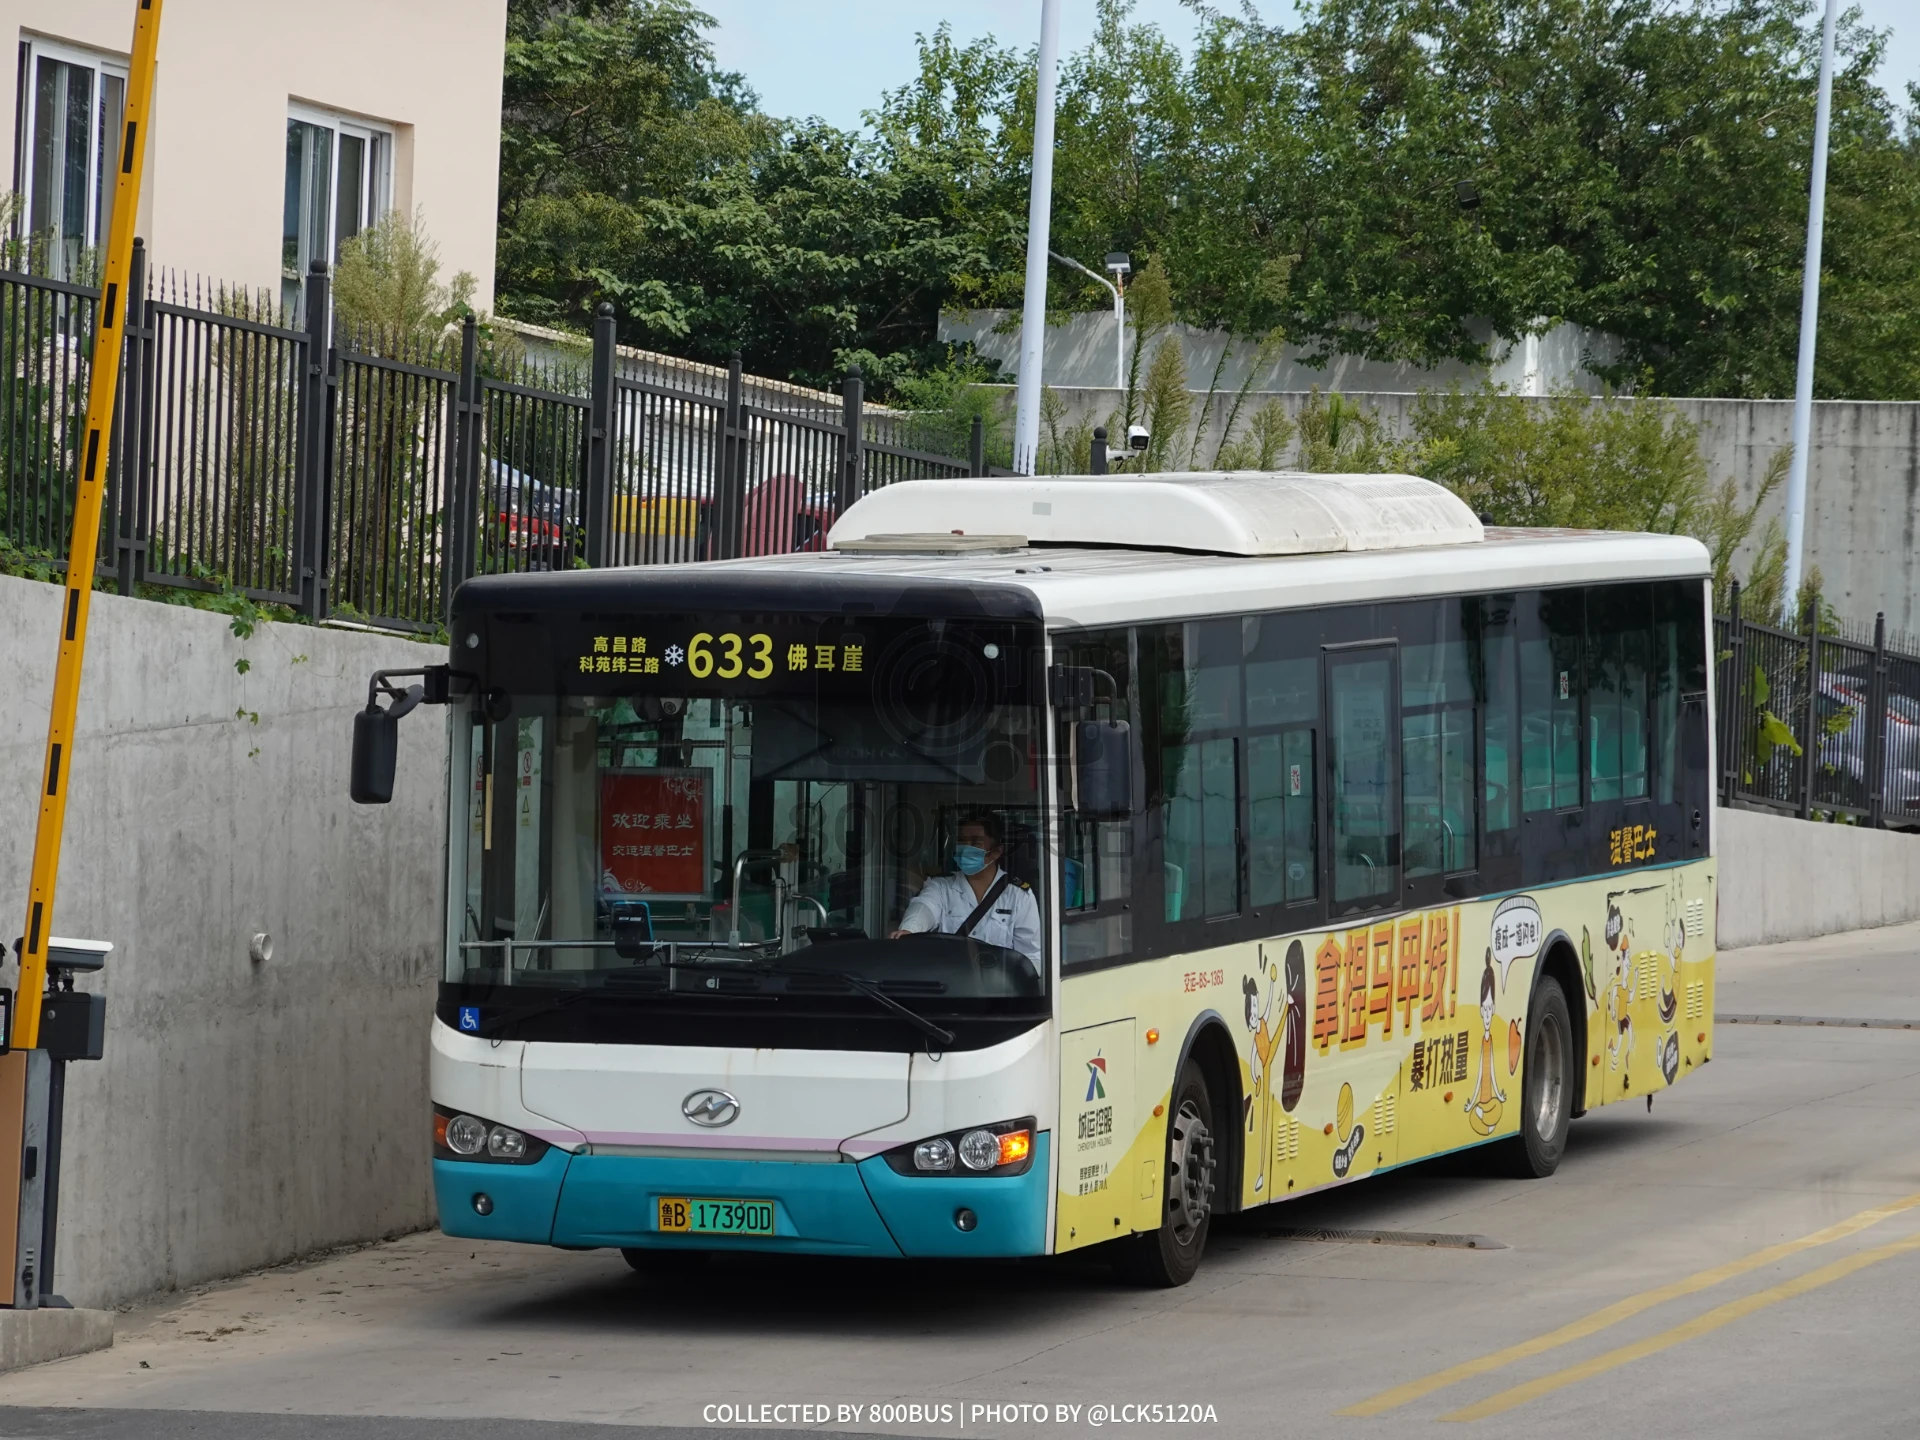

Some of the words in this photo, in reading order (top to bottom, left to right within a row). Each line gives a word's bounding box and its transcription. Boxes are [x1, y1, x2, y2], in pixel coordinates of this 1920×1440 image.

[593, 635, 647, 654] 高昌路
[687, 632, 774, 679] 633
[787, 643, 864, 673] 佛耳崖
[579, 655, 660, 674] 科苑纬三路
[611, 812, 695, 830] 欢迎乘坐
[611, 844, 695, 857] 交运温馨巴士
[1610, 824, 1658, 866] 温馨巴士
[1410, 1030, 1470, 1092] 暴打热量
[1077, 1105, 1113, 1141] 城运控股
[661, 1202, 686, 1228] 鲁B
[698, 1204, 771, 1231] 17390D
